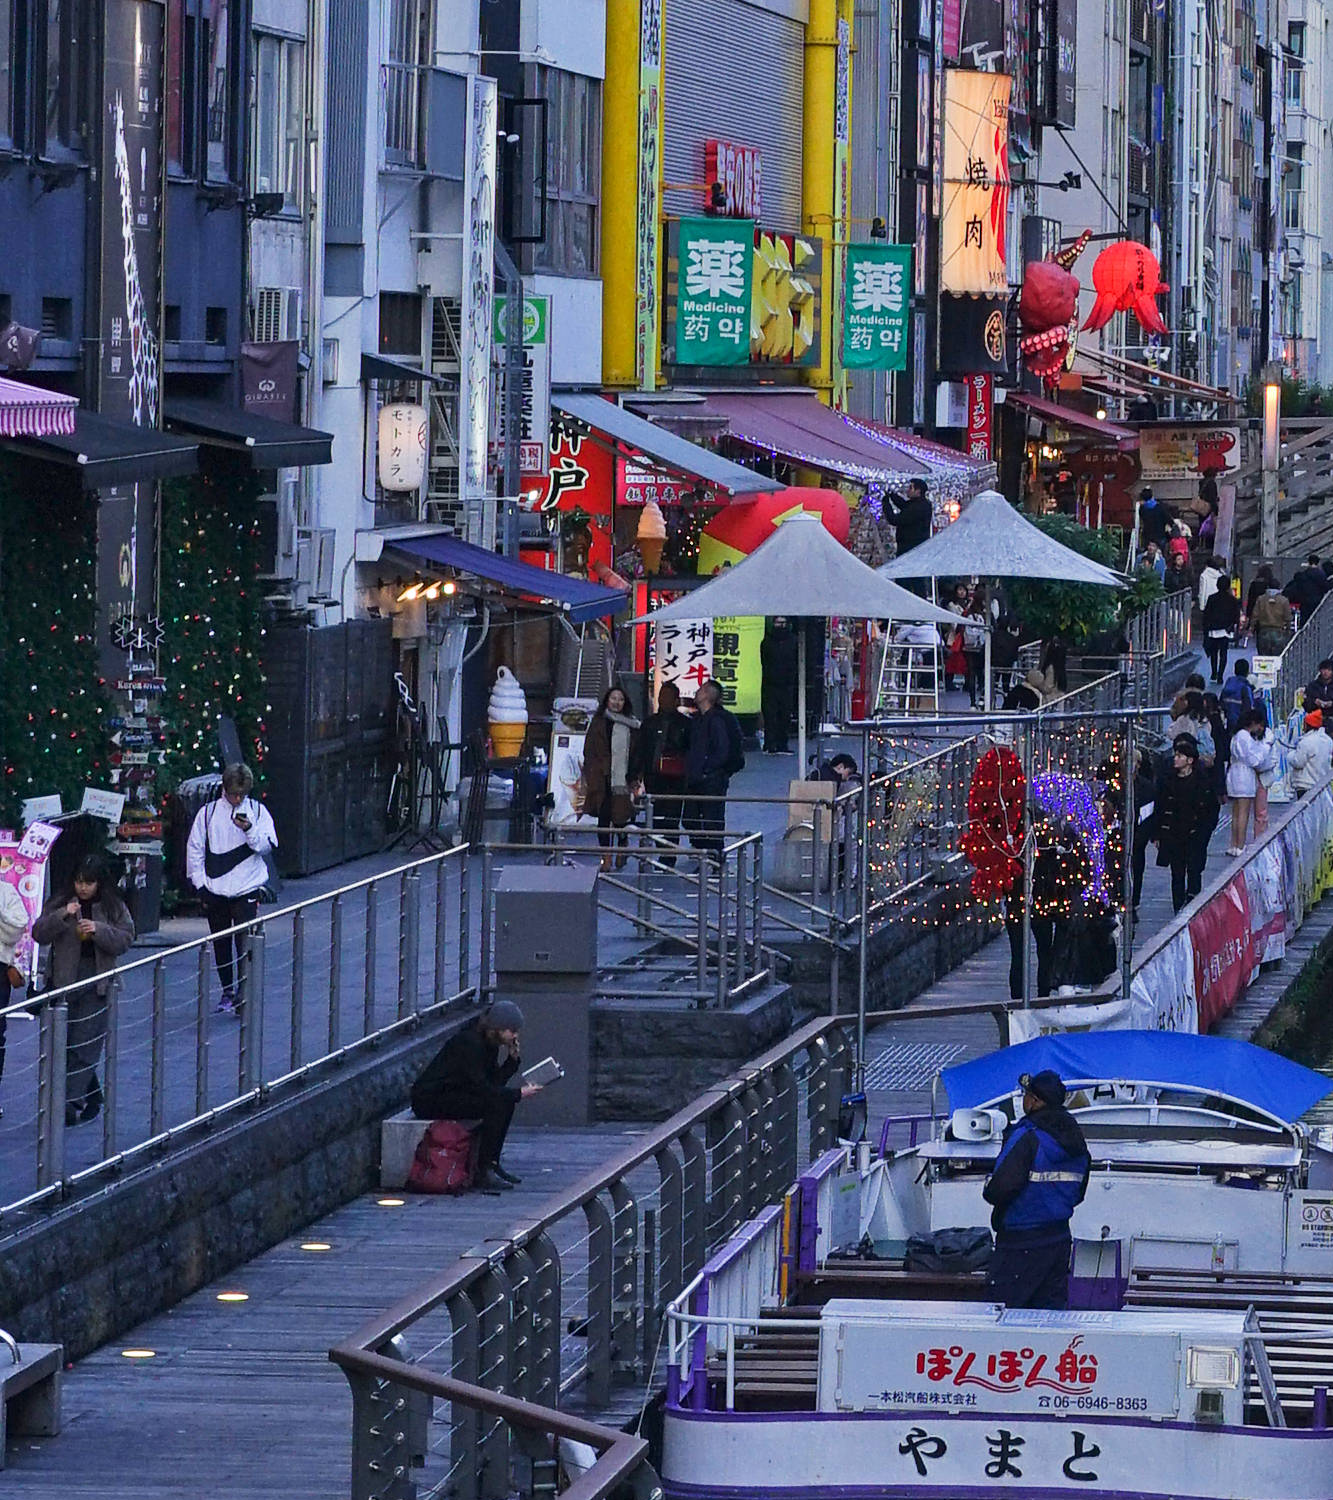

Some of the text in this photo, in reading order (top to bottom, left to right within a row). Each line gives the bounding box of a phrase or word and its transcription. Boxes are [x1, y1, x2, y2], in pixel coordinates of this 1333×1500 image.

[964, 156, 991, 251] 焼肉
[686, 239, 746, 298] 薬
[852, 260, 904, 312] 薬
[683, 301, 745, 315] Medicine
[850, 314, 903, 327] Medicine
[686, 622, 711, 687] 神戸牛
[916, 1345, 1098, 1391] ぽんぽん船
[1053, 1395, 1149, 1411] 06-6946-8363
[898, 1426, 1102, 1482] やまと
